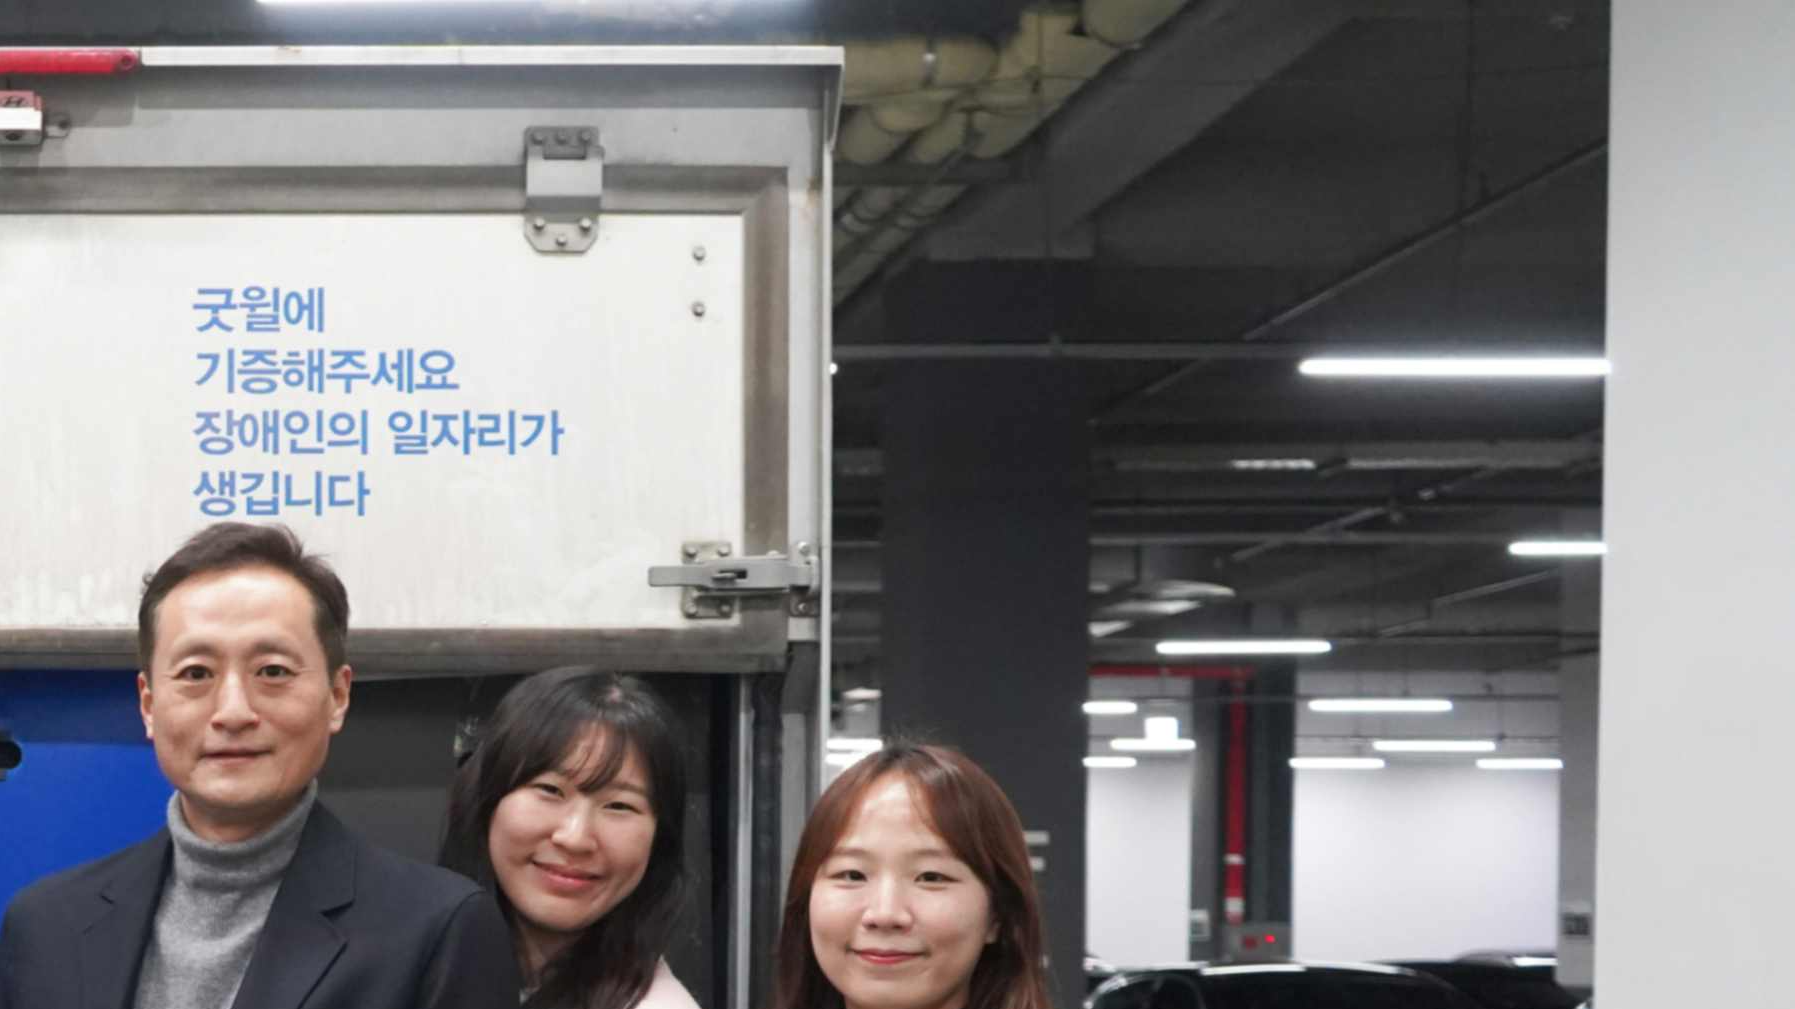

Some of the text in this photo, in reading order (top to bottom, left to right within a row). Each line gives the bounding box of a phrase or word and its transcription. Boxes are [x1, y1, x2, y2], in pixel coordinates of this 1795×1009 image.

[192, 286, 325, 333] 굿윌에
[195, 347, 460, 395] 기증해주세요
[192, 410, 564, 455] 장애인의 일자리가
[192, 471, 371, 517] 생깁니다
